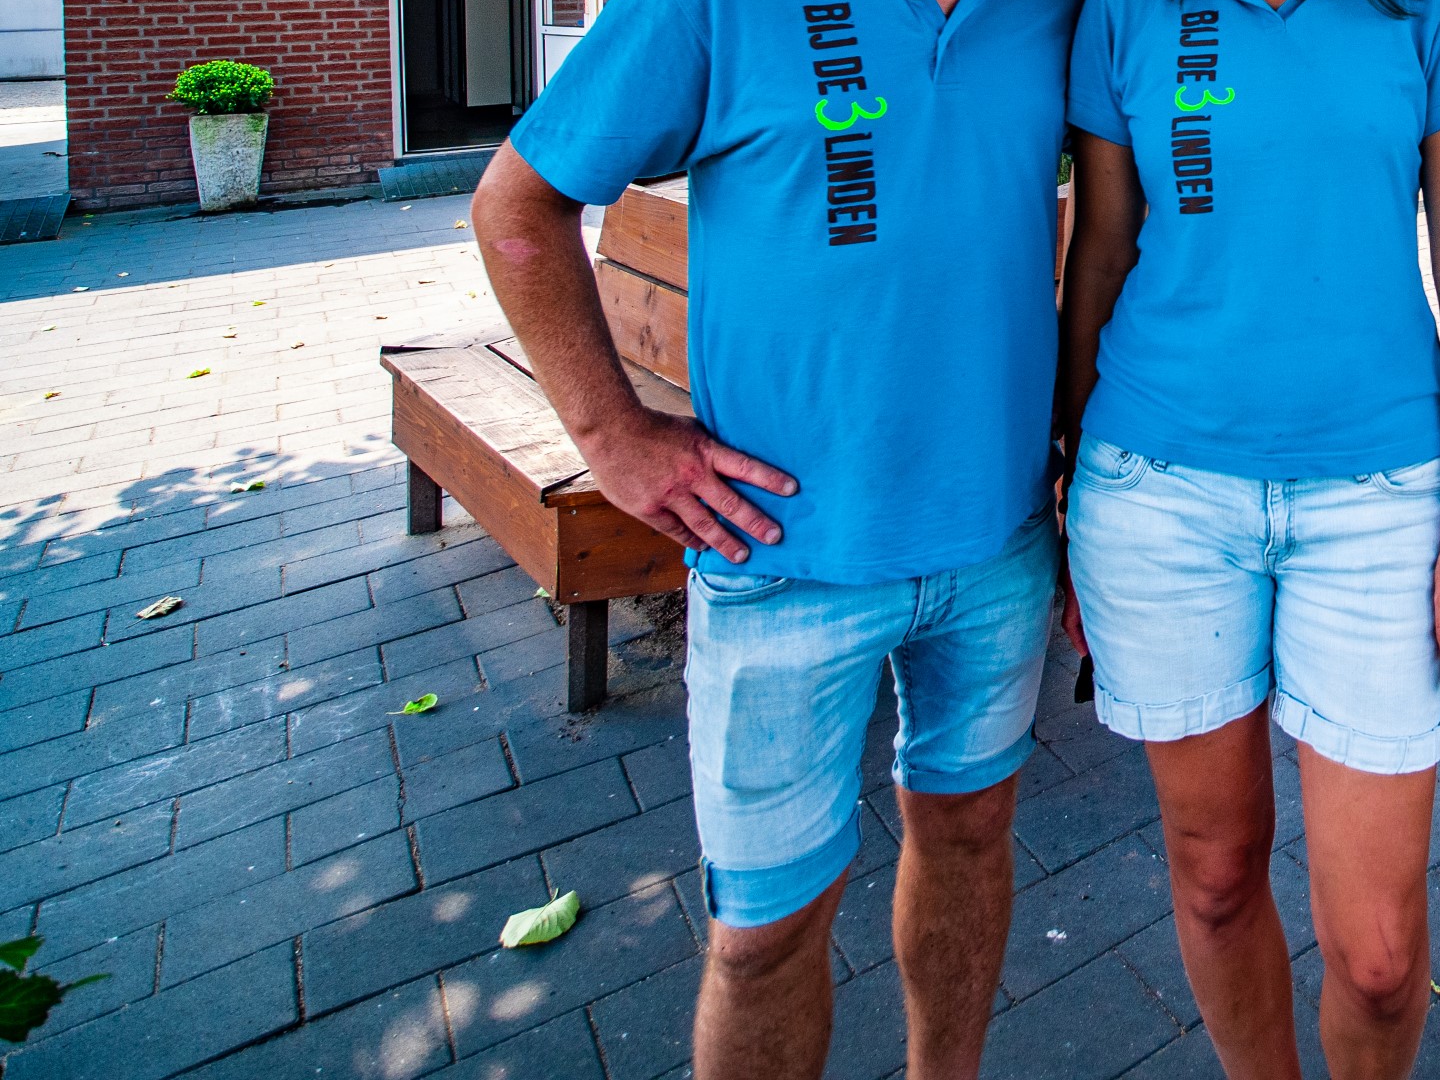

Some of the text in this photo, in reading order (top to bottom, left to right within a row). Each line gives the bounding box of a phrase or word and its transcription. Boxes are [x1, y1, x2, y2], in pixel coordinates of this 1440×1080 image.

[803, 2, 888, 246] BIJ DE 3 LINDEN
[1171, 10, 1236, 215] BIJ DE 3 LINDEN
